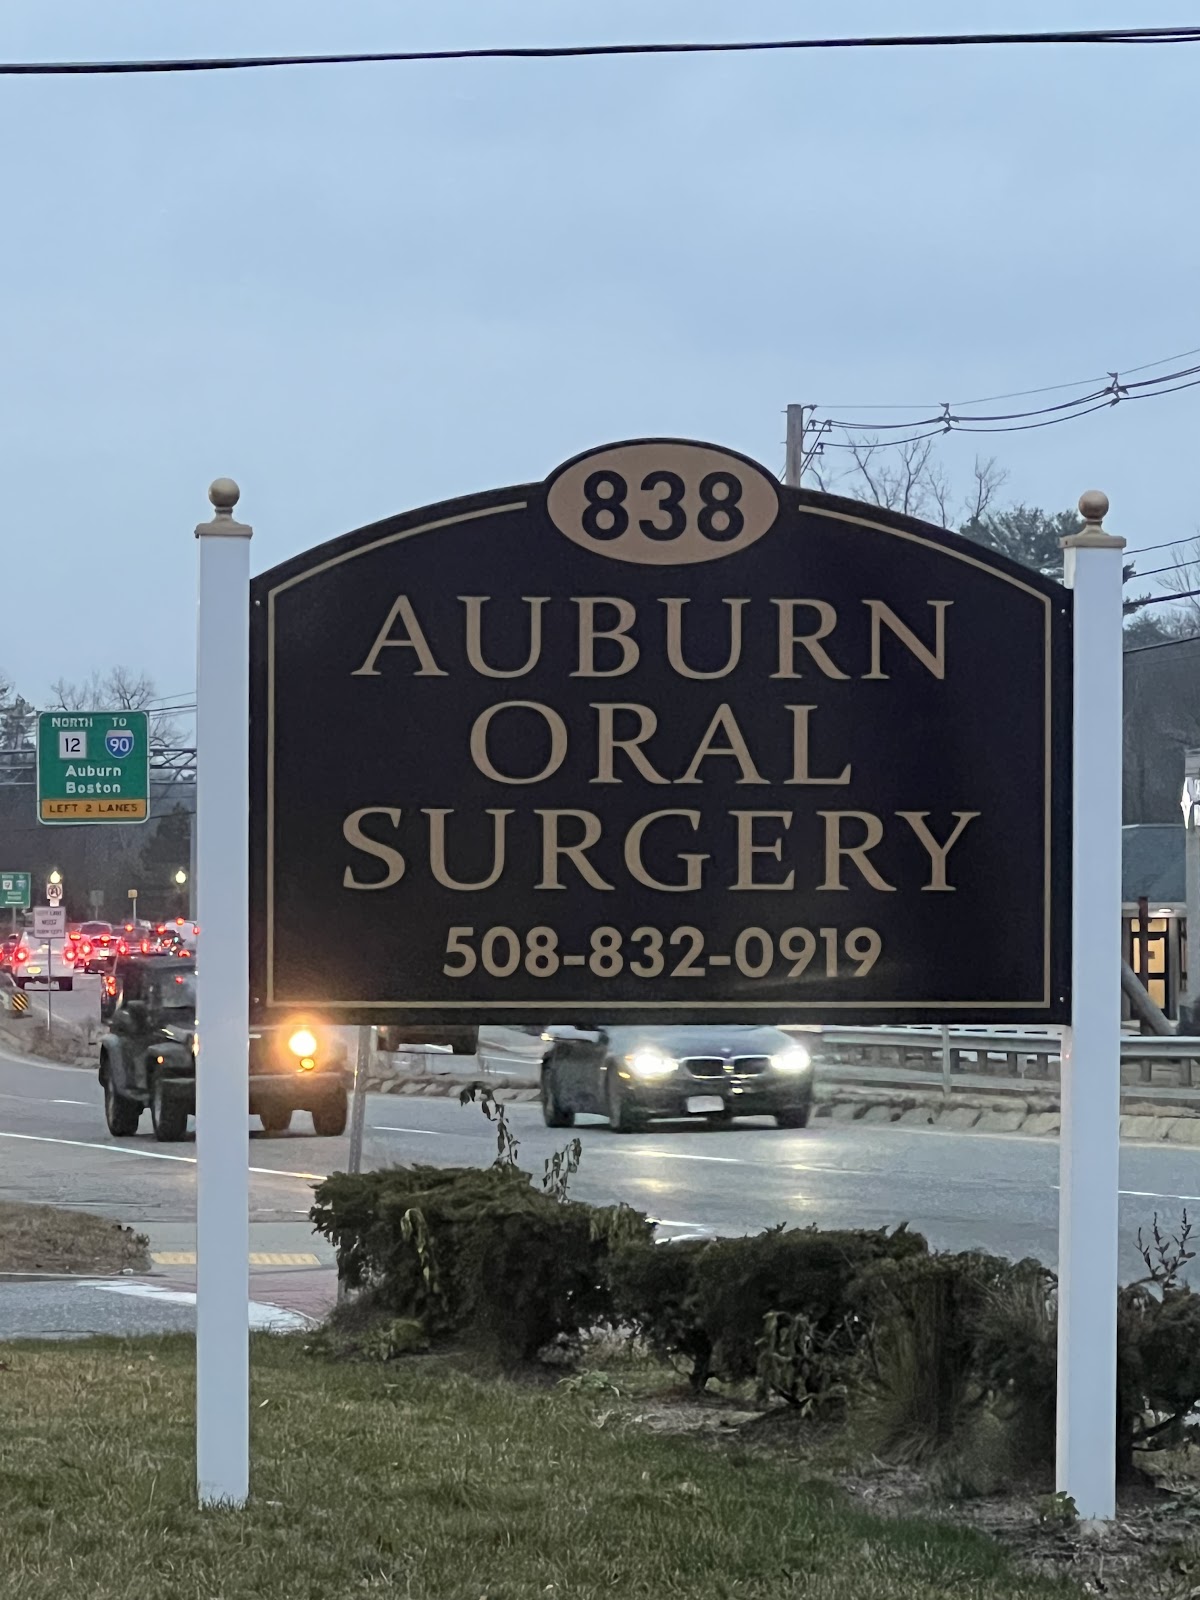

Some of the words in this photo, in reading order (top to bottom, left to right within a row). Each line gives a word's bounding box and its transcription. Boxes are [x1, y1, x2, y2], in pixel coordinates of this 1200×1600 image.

[581, 470, 744, 542] 838
[352, 595, 955, 680] AUBURN
[51, 717, 93, 728] NORTH
[112, 717, 127, 727] TO
[64, 737, 81, 753] 12
[109, 738, 130, 752] 90
[470, 701, 853, 787] ORAL
[65, 765, 122, 777] Auburn
[65, 781, 121, 794] Boston
[49, 804, 78, 813] LEFT
[85, 804, 92, 812] 2
[98, 803, 138, 812] LANES
[342, 807, 982, 893] SURGERY
[442, 926, 882, 979] 508-832-0919
